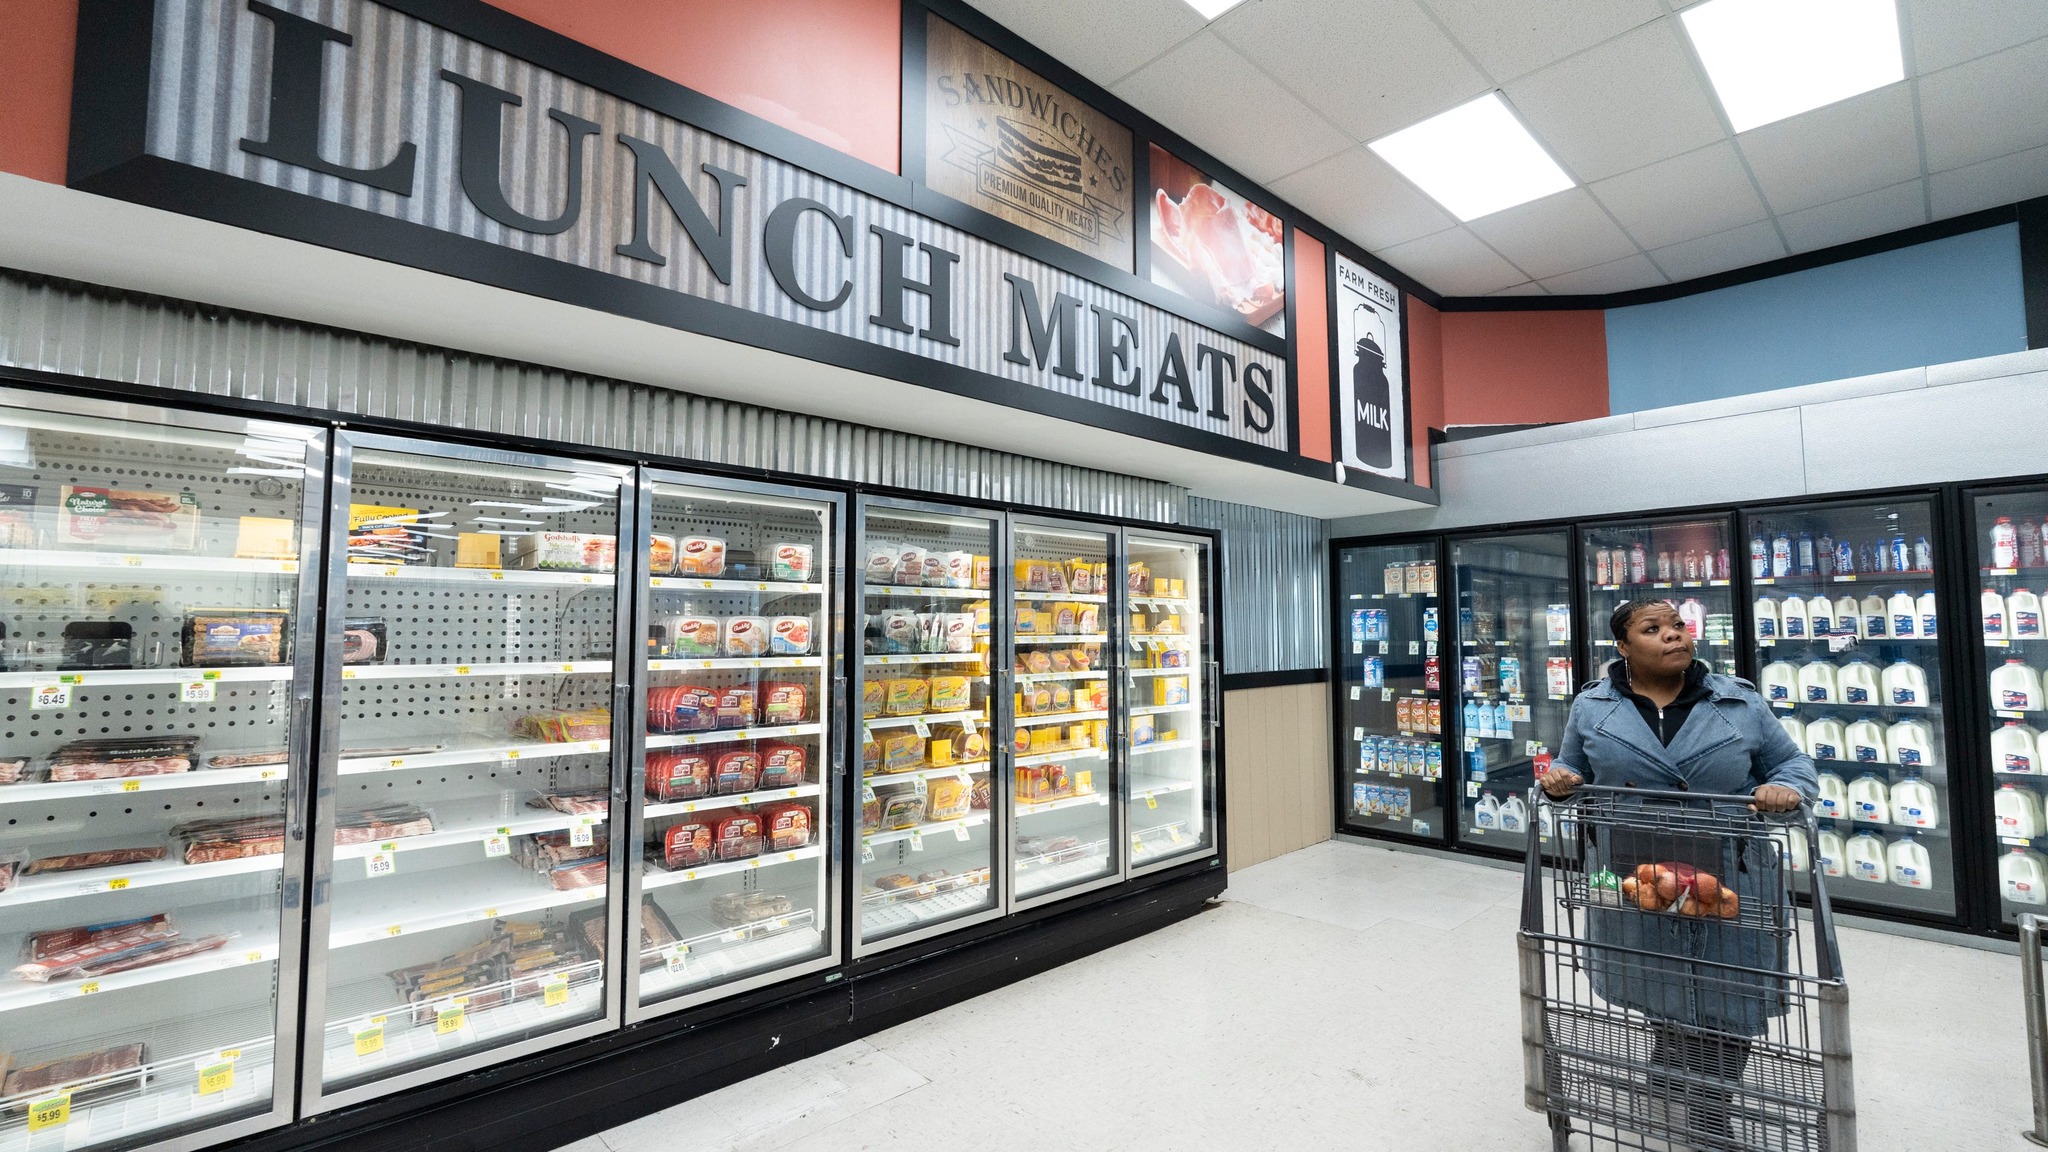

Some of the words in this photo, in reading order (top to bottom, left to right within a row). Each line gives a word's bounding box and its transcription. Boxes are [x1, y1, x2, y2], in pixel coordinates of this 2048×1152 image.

[937, 72, 1127, 193] SANDWICHES
[983, 169, 1027, 203] PREMIUM
[1029, 191, 1065, 220] QUALITY
[1066, 206, 1094, 232] MEATS
[239, 0, 960, 347] LUNCH
[1003, 271, 1276, 433] MEATS
[1339, 265, 1365, 290] FARM
[1368, 281, 1396, 306] FRESH
[1357, 398, 1390, 432] MILK
[69, 497, 108, 508] Natural
[75, 505, 106, 513] Choice
[353, 515, 376, 523] Fully
[1425, 666, 1439, 674] Silk
[38, 694, 66, 705] $6.45
[185, 689, 210, 699] $5.99
[206, 1074, 226, 1087] $5.99
[37, 1109, 61, 1123] $5.99
